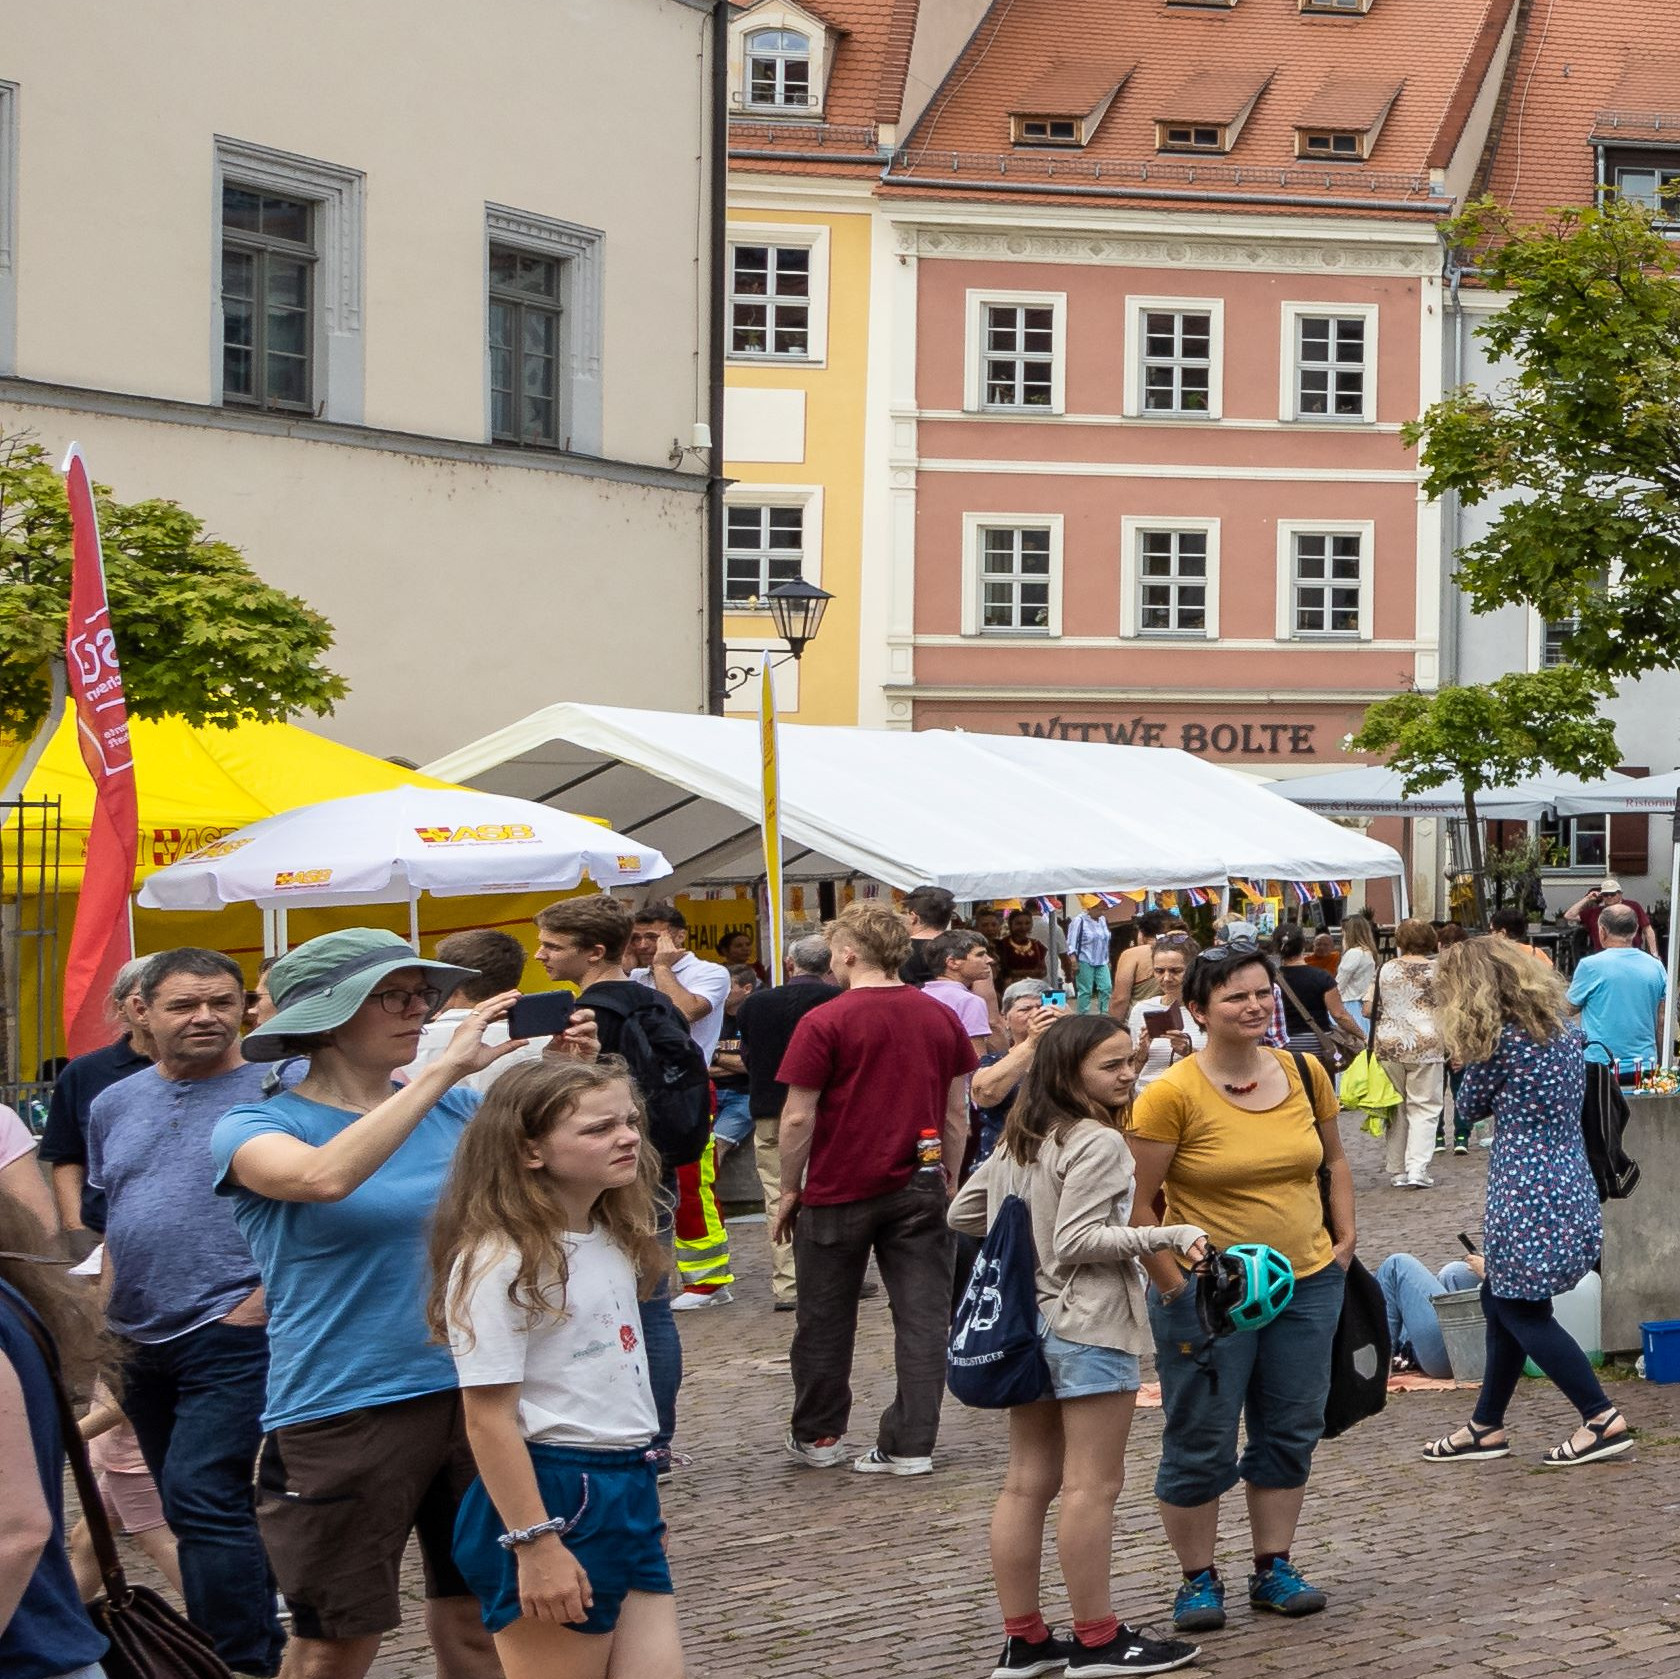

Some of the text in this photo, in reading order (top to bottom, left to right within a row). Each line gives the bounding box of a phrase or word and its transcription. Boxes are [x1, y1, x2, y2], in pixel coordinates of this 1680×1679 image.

[1180, 723, 1315, 755] BOLTE
[1345, 802, 1391, 811] Pizzeria
[451, 824, 535, 841] ASB
